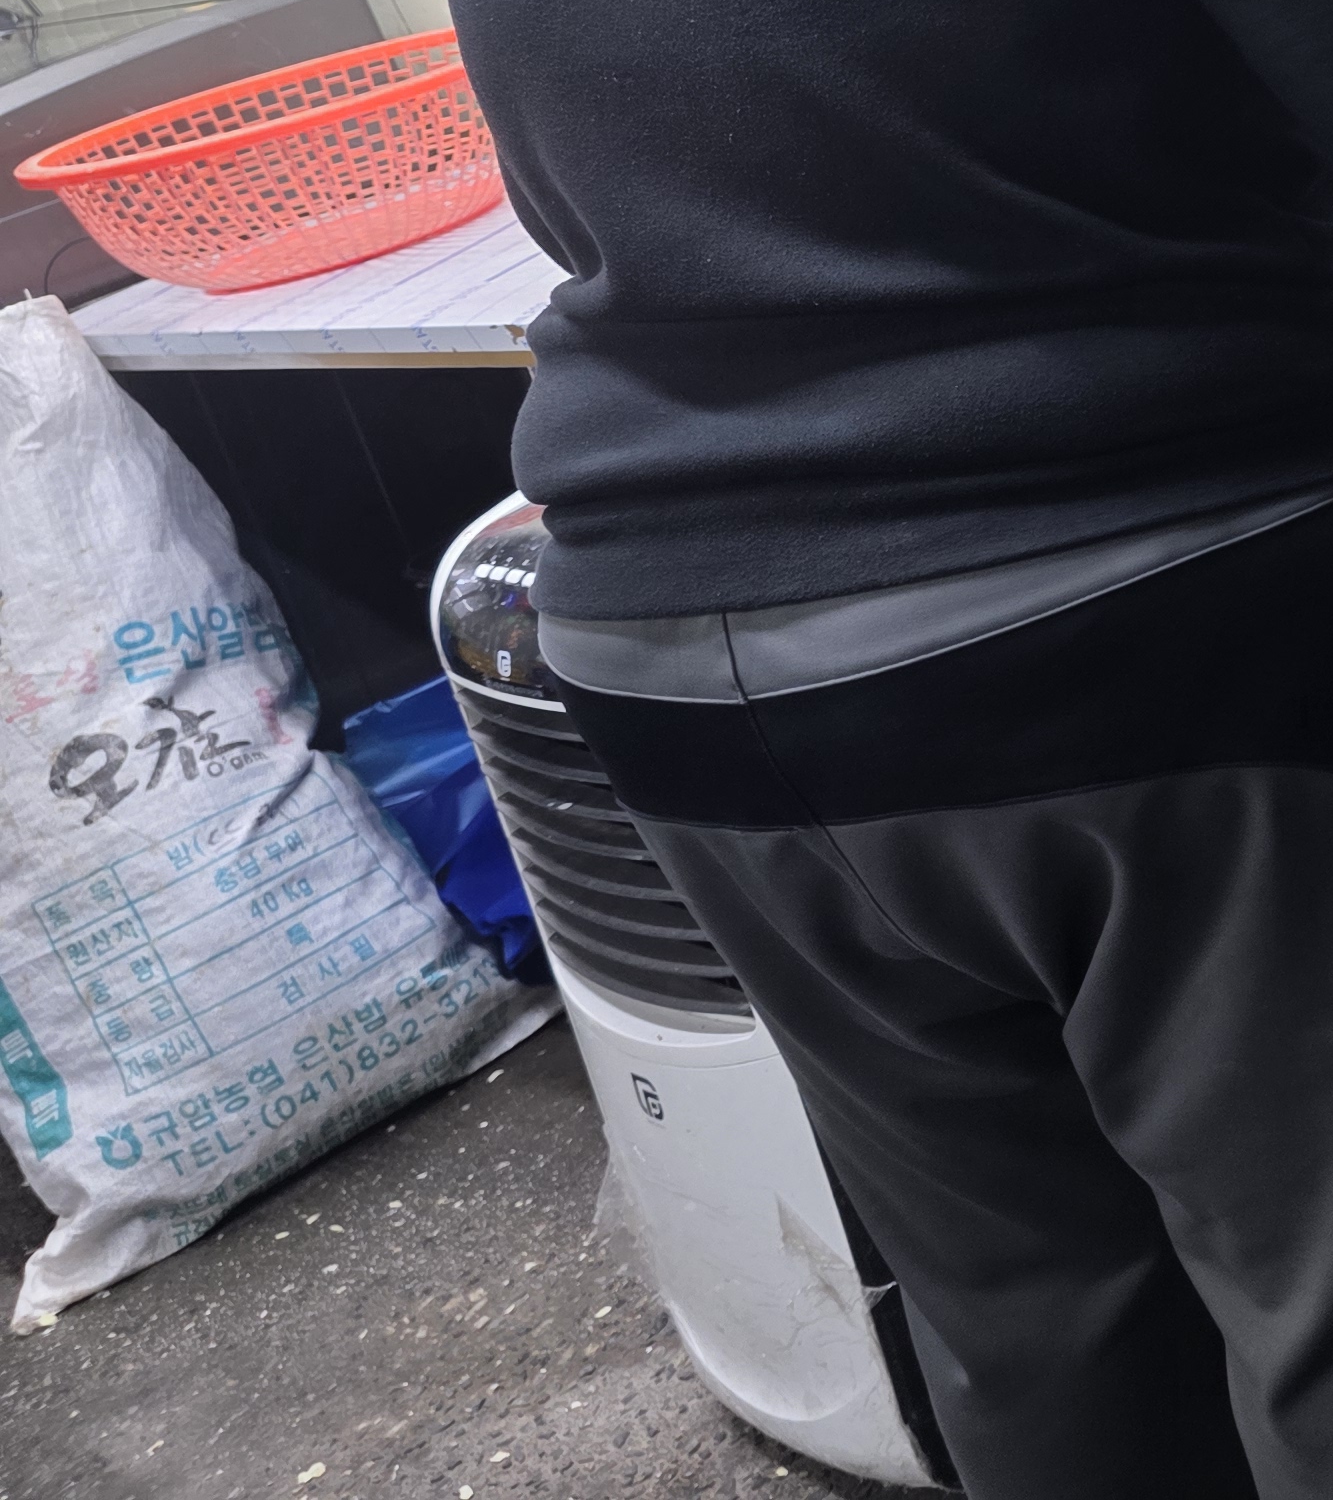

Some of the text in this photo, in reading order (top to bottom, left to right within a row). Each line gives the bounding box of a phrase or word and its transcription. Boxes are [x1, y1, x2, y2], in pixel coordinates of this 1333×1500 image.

[113, 601, 290, 685] 은산알밤
[66, 830, 306, 968] 원산지 충남 부여
[250, 891, 279, 919] 40
[124, 1031, 198, 1079] 자율검사
[143, 1059, 286, 1149] 규암농협
[293, 997, 388, 1073] 은산밤
